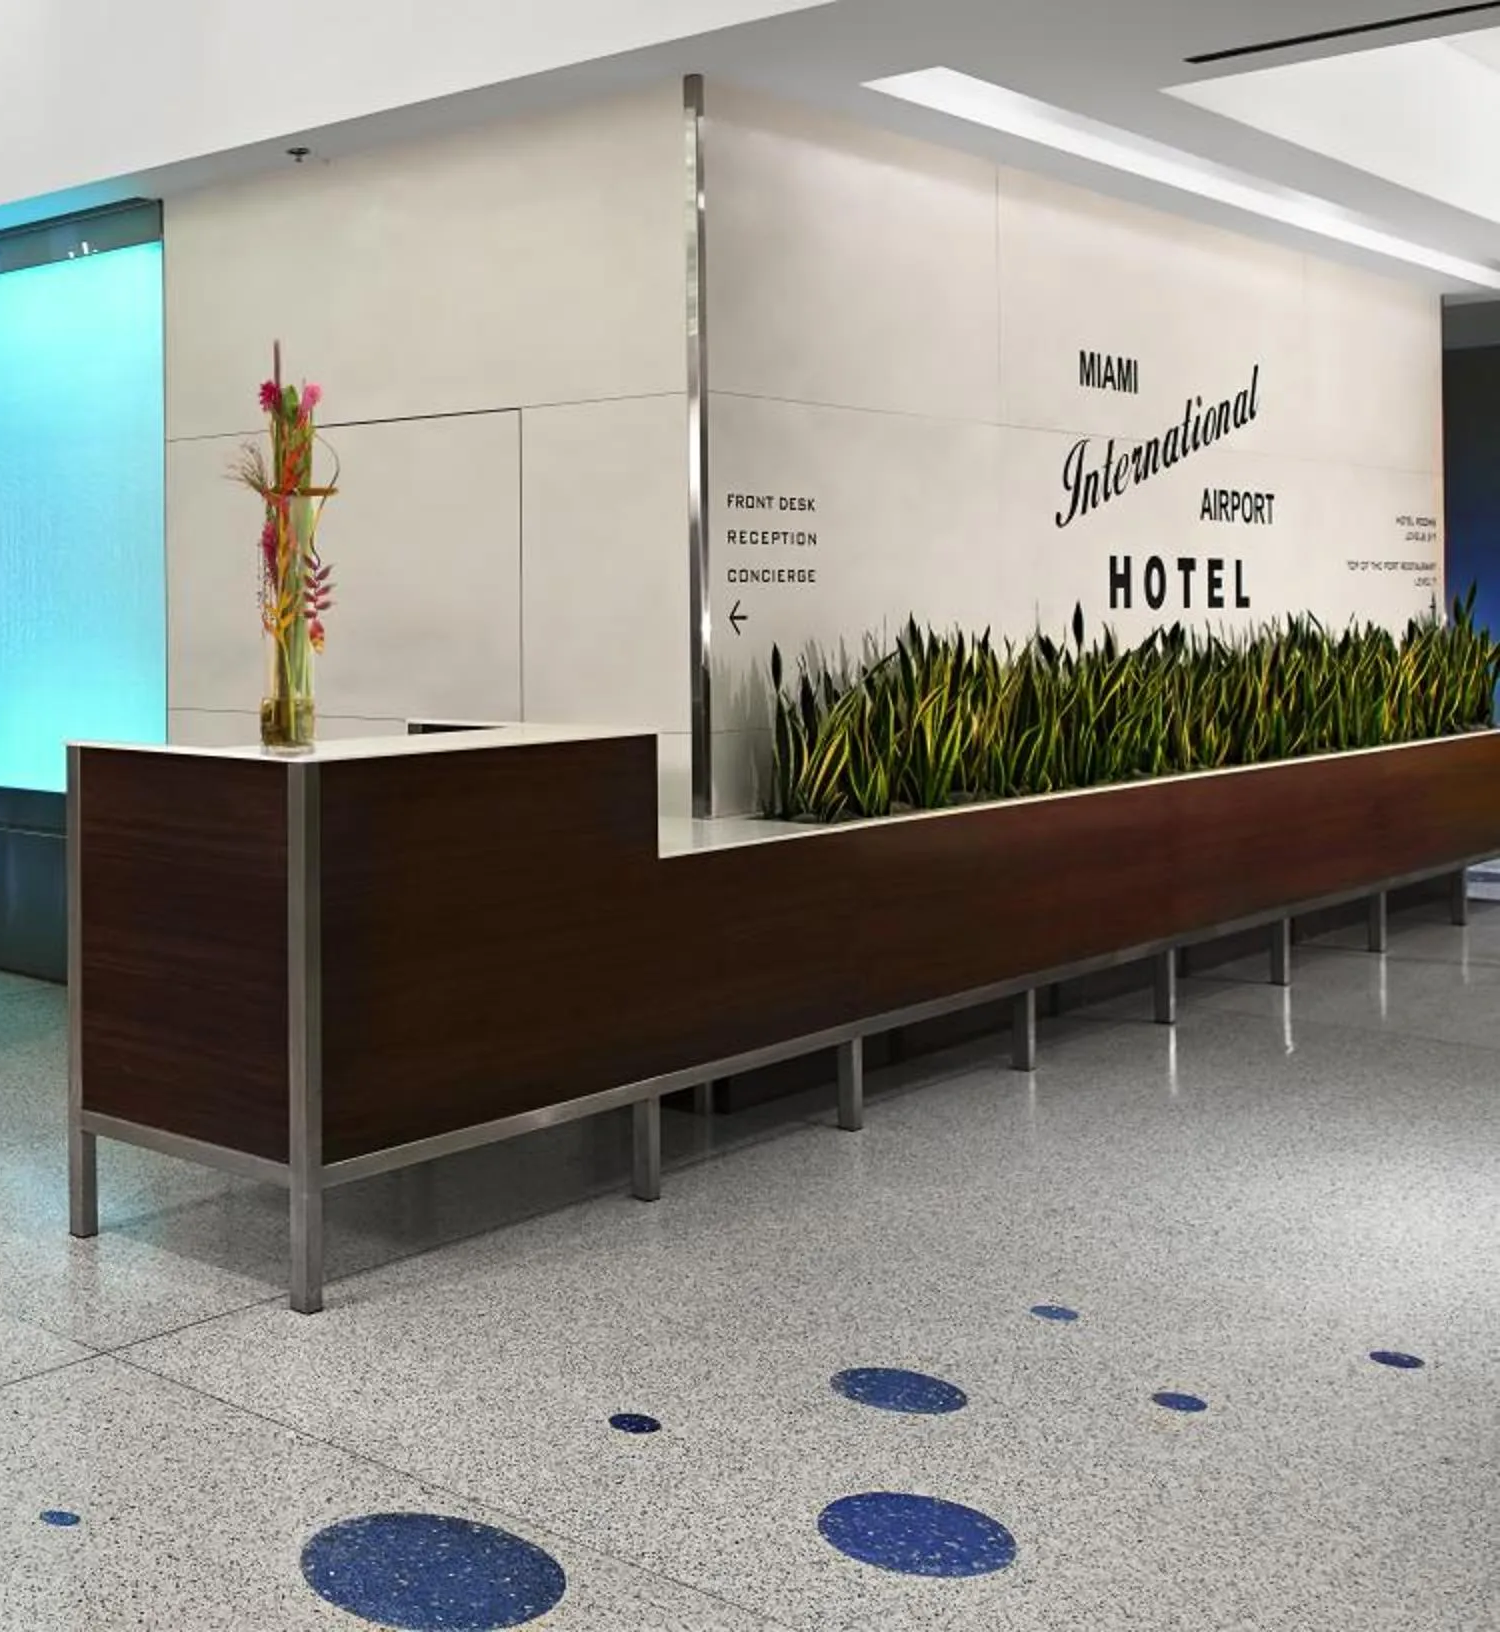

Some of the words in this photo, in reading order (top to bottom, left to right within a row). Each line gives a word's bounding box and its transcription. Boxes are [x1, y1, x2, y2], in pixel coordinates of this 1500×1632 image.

[1079, 350, 1139, 394] MIAMI
[1055, 364, 1259, 528] International
[727, 493, 775, 509] FRONT
[779, 496, 816, 511] DESK
[1200, 488, 1275, 525] AIRPORT
[727, 529, 817, 546] RECEPTION
[727, 568, 816, 583] CONCIERGE
[1109, 555, 1251, 610] HOTEL
